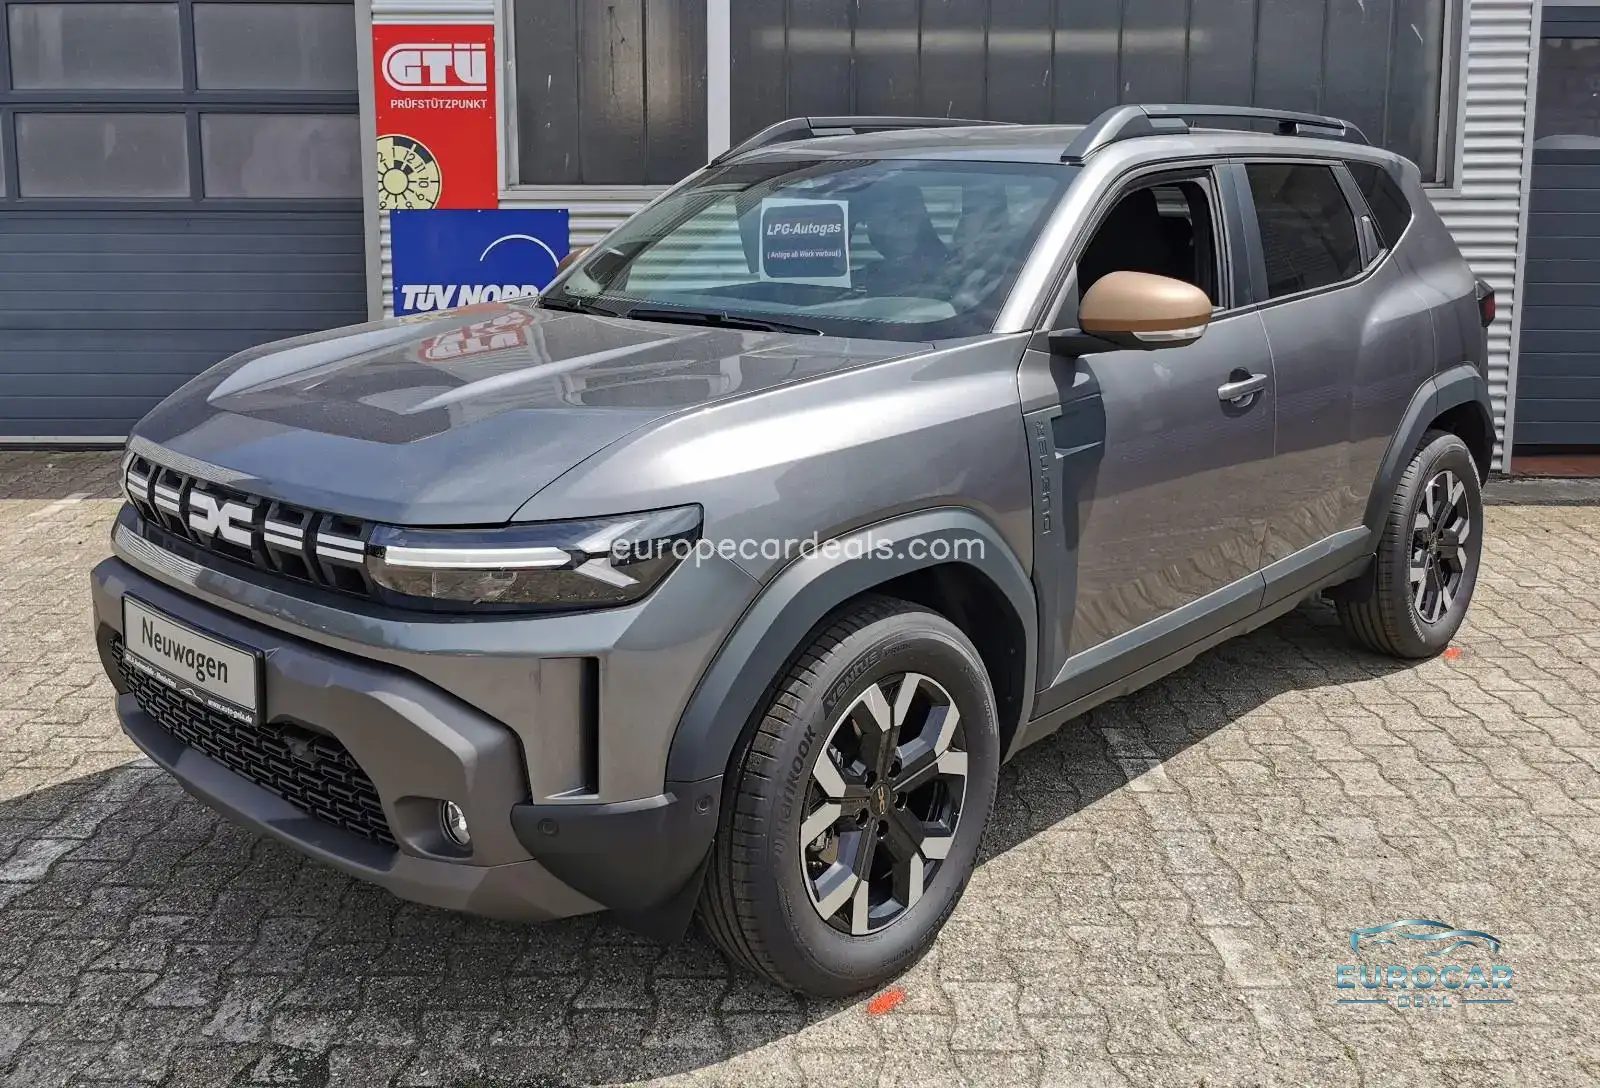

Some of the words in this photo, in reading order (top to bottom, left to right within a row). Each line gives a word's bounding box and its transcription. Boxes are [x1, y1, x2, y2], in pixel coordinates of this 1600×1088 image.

[382, 43, 487, 91] GTÜ
[390, 98, 487, 109] PRÜFSTÜTZPUNKT
[404, 150, 416, 164] 12
[414, 162, 426, 173] 11
[418, 176, 429, 188] 10
[766, 222, 841, 236] LPG-Autogas
[401, 284, 457, 311] TÜV
[142, 616, 228, 684] Neuwagen
